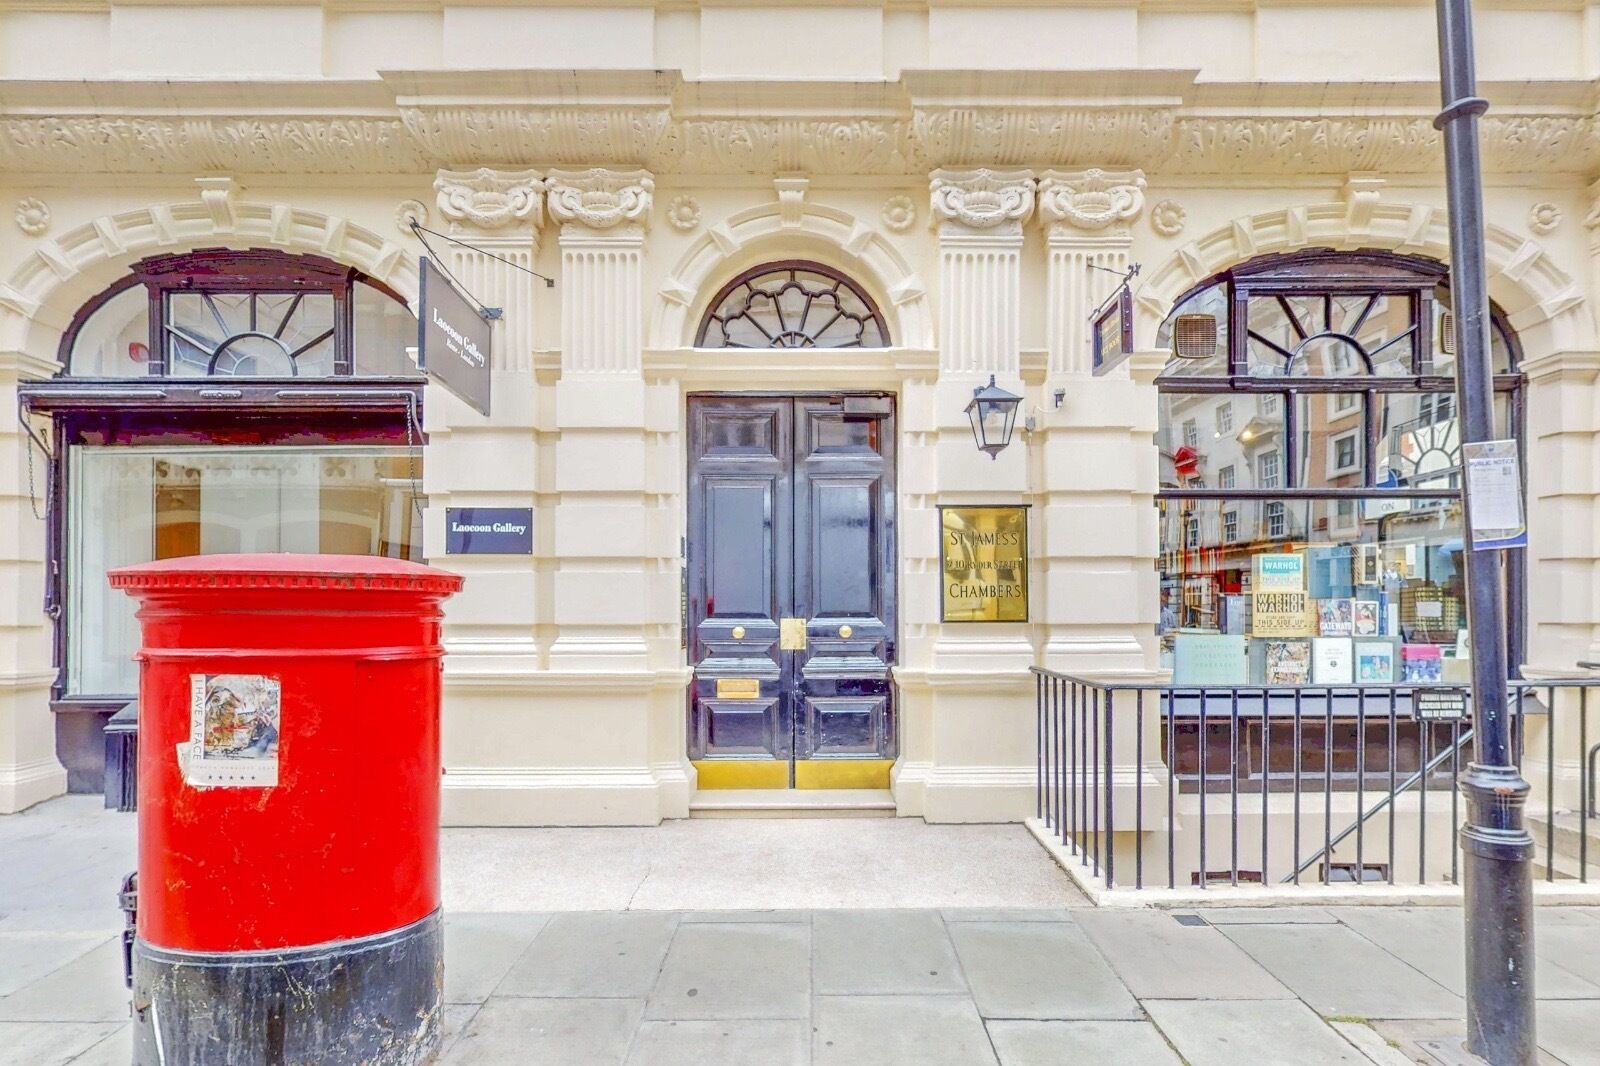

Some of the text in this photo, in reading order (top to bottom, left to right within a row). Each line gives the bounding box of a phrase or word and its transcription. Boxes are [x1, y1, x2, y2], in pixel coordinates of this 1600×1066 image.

[433, 307, 485, 368] Laocoon Gallery
[451, 521, 527, 535] Laocoon Gallery
[1264, 561, 1298, 570] WARHOL
[949, 583, 1022, 598] CHAMBERS
[1257, 594, 1304, 603] WARHOL
[1257, 603, 1304, 612] WARHOL
[194, 687, 203, 717] HAVE
[192, 733, 202, 760] FACE
